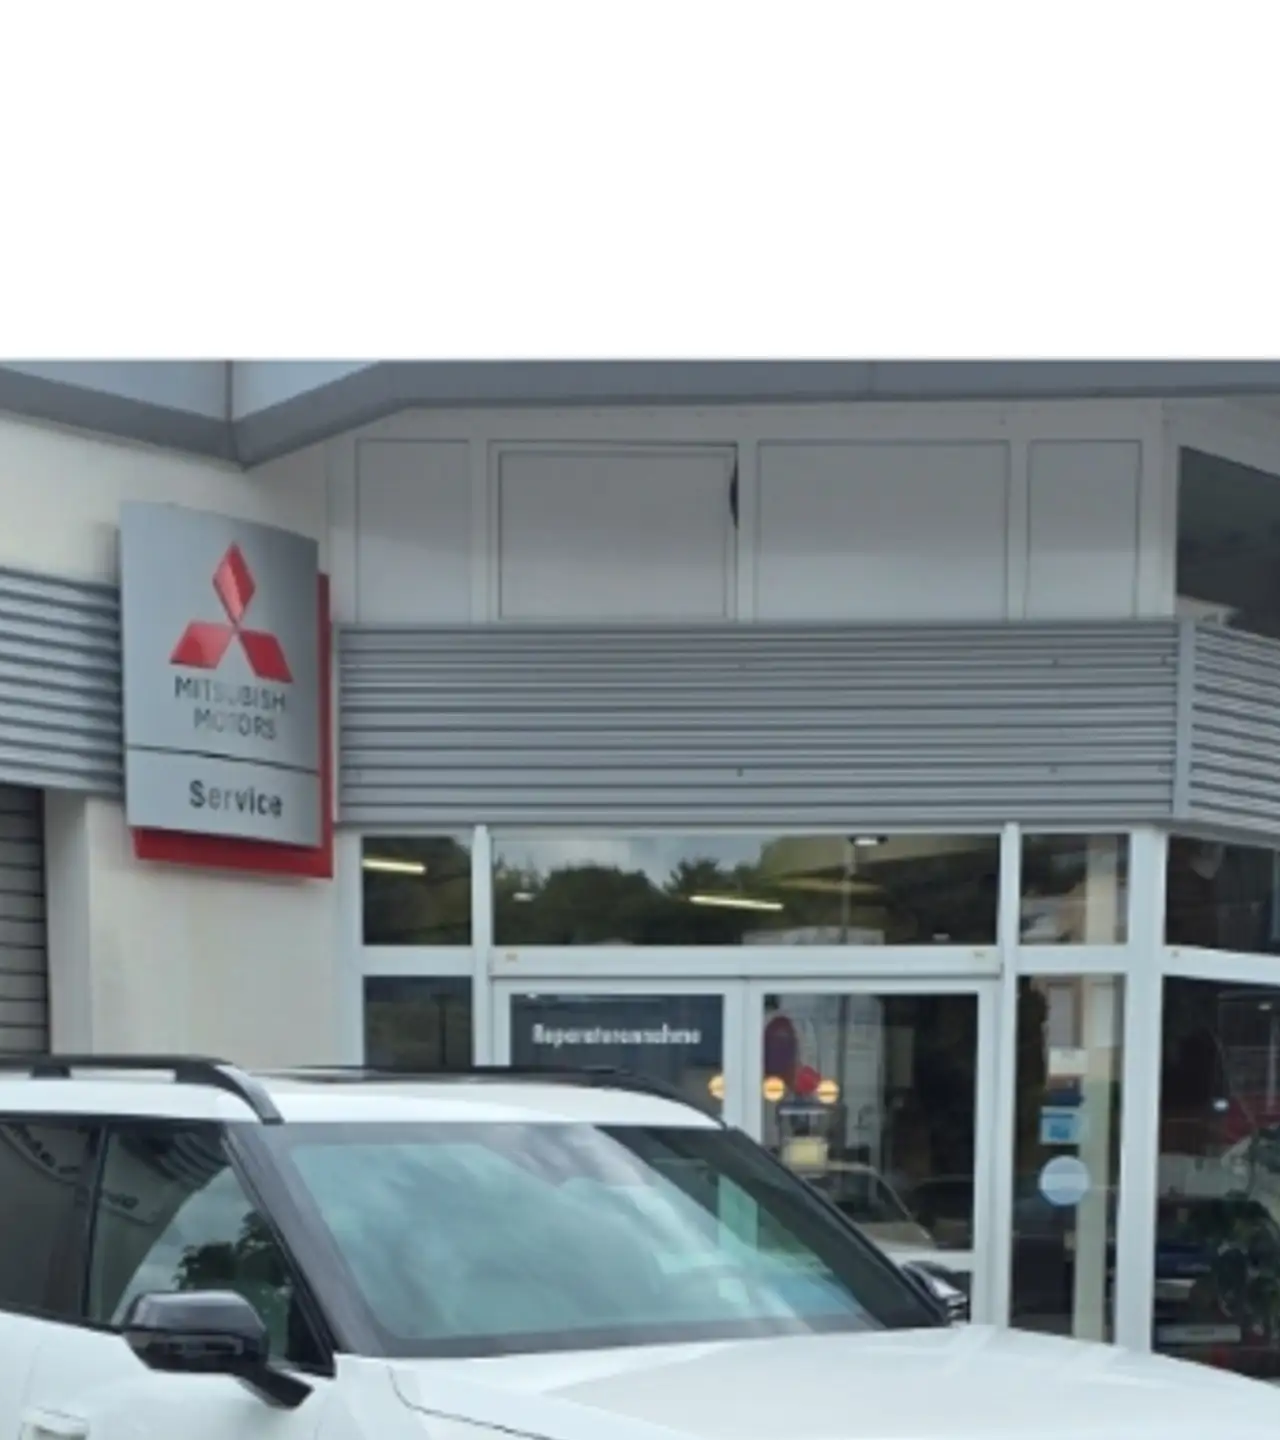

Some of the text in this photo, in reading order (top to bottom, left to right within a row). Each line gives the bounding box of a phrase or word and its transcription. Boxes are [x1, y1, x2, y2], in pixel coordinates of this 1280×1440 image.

[174, 675, 286, 712] MITSUBISH
[193, 707, 277, 741] MOTORS
[189, 779, 284, 819] Service
